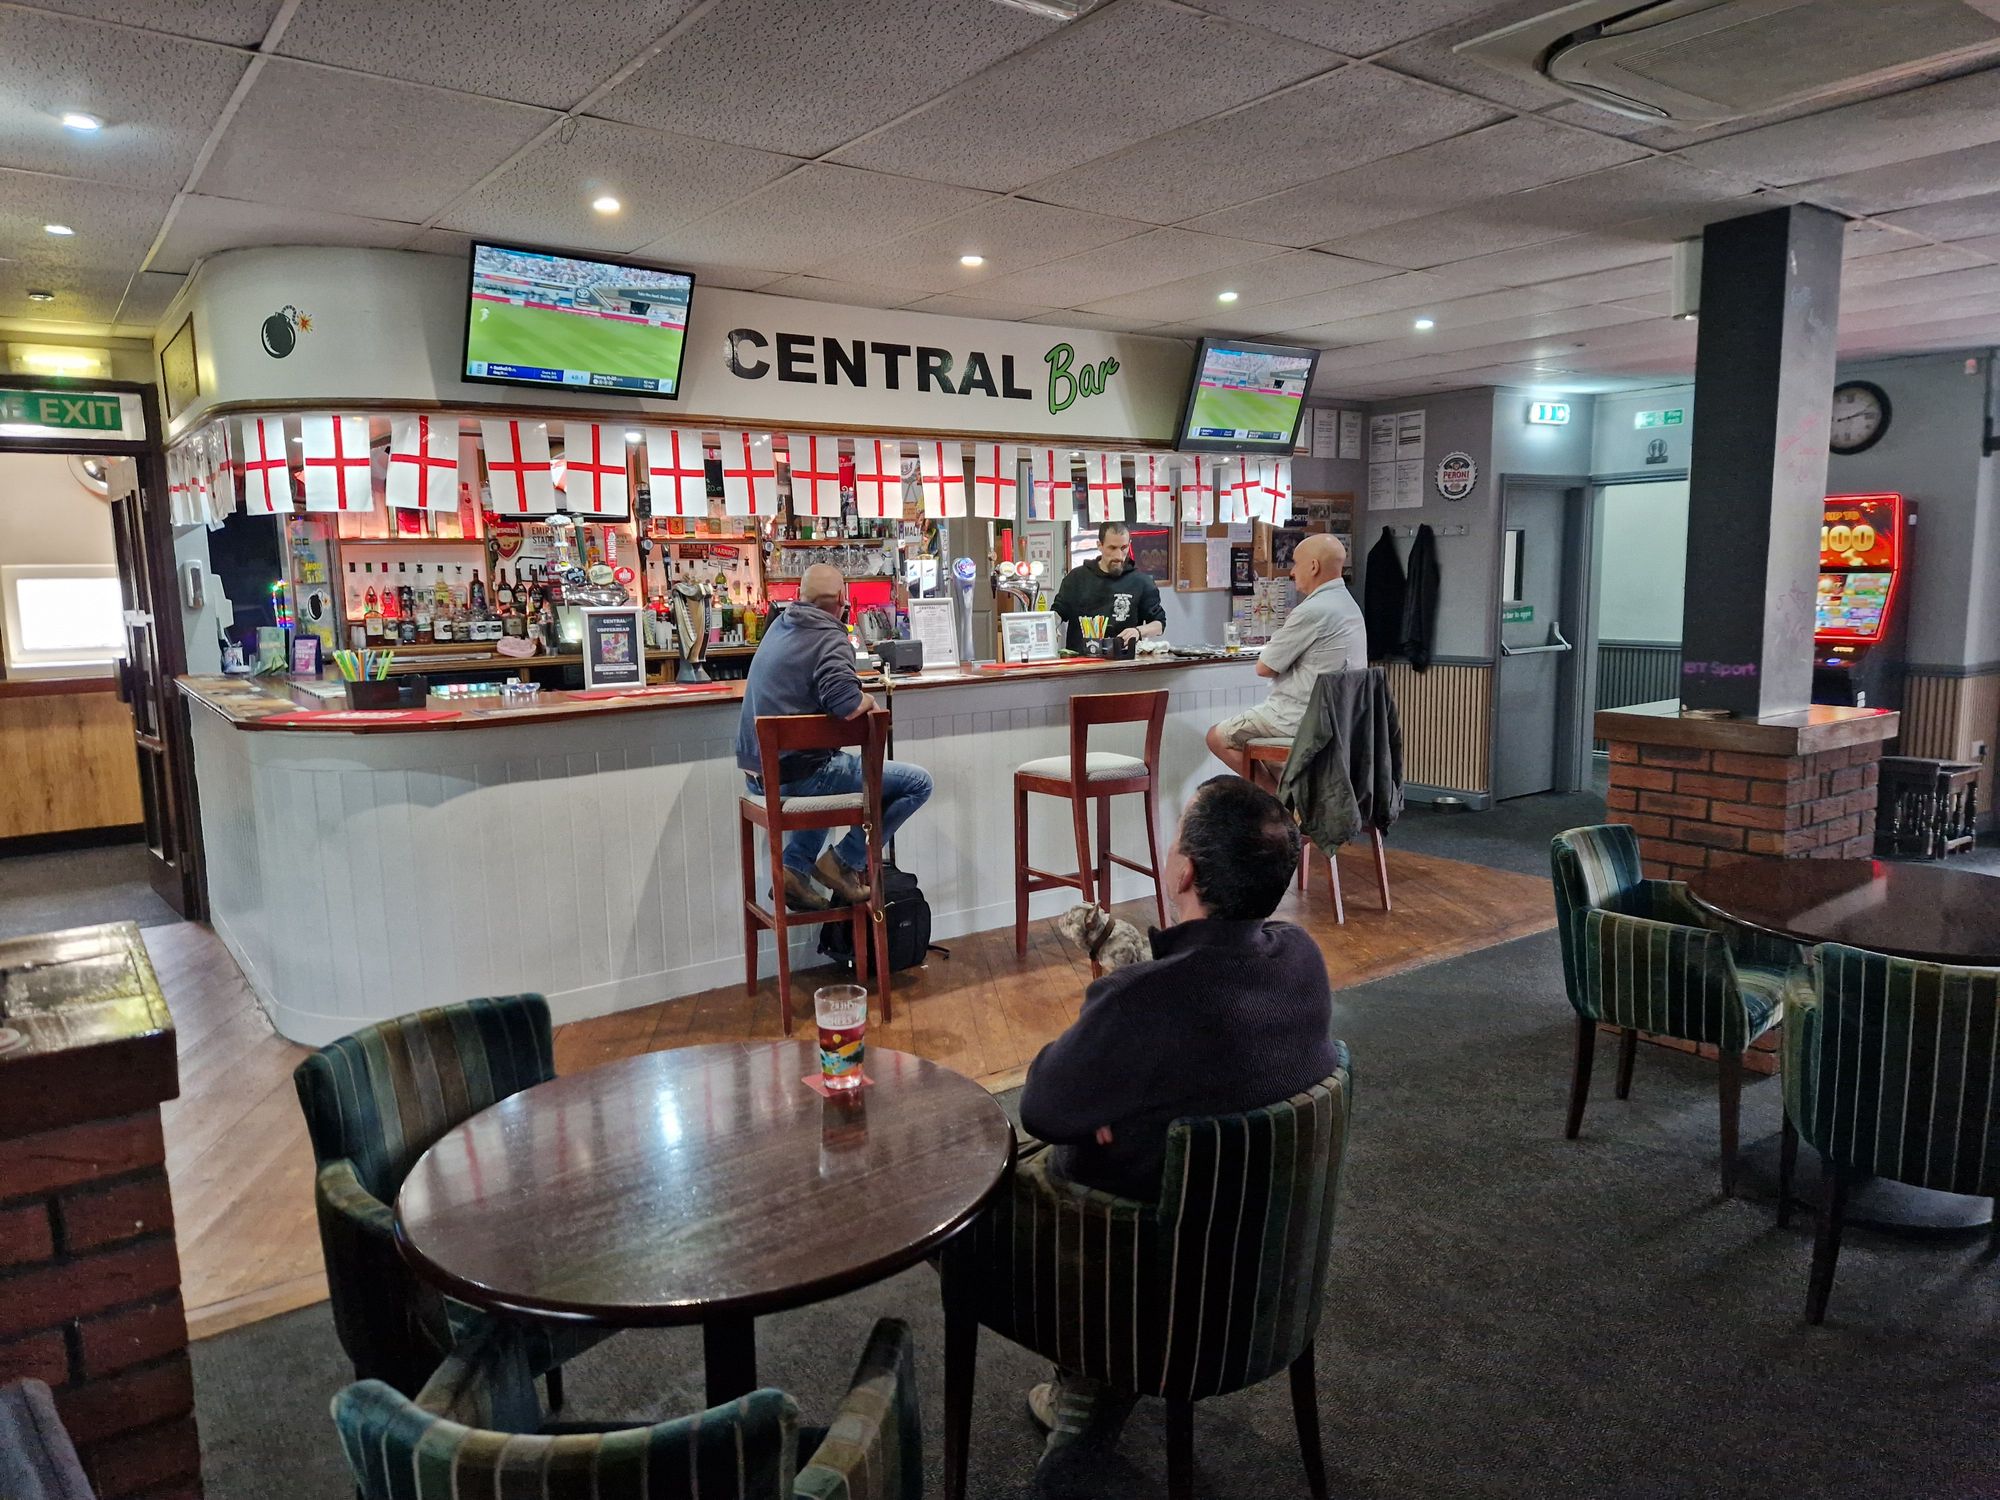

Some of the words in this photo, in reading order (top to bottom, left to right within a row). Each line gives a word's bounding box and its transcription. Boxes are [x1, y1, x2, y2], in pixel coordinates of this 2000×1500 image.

[723, 328, 1032, 400] CENTRAL
[1044, 342, 1121, 415] Bar
[40, 398, 118, 426] EXIT
[1443, 471, 1470, 479] PERONI
[1710, 661, 1757, 677] Sport
